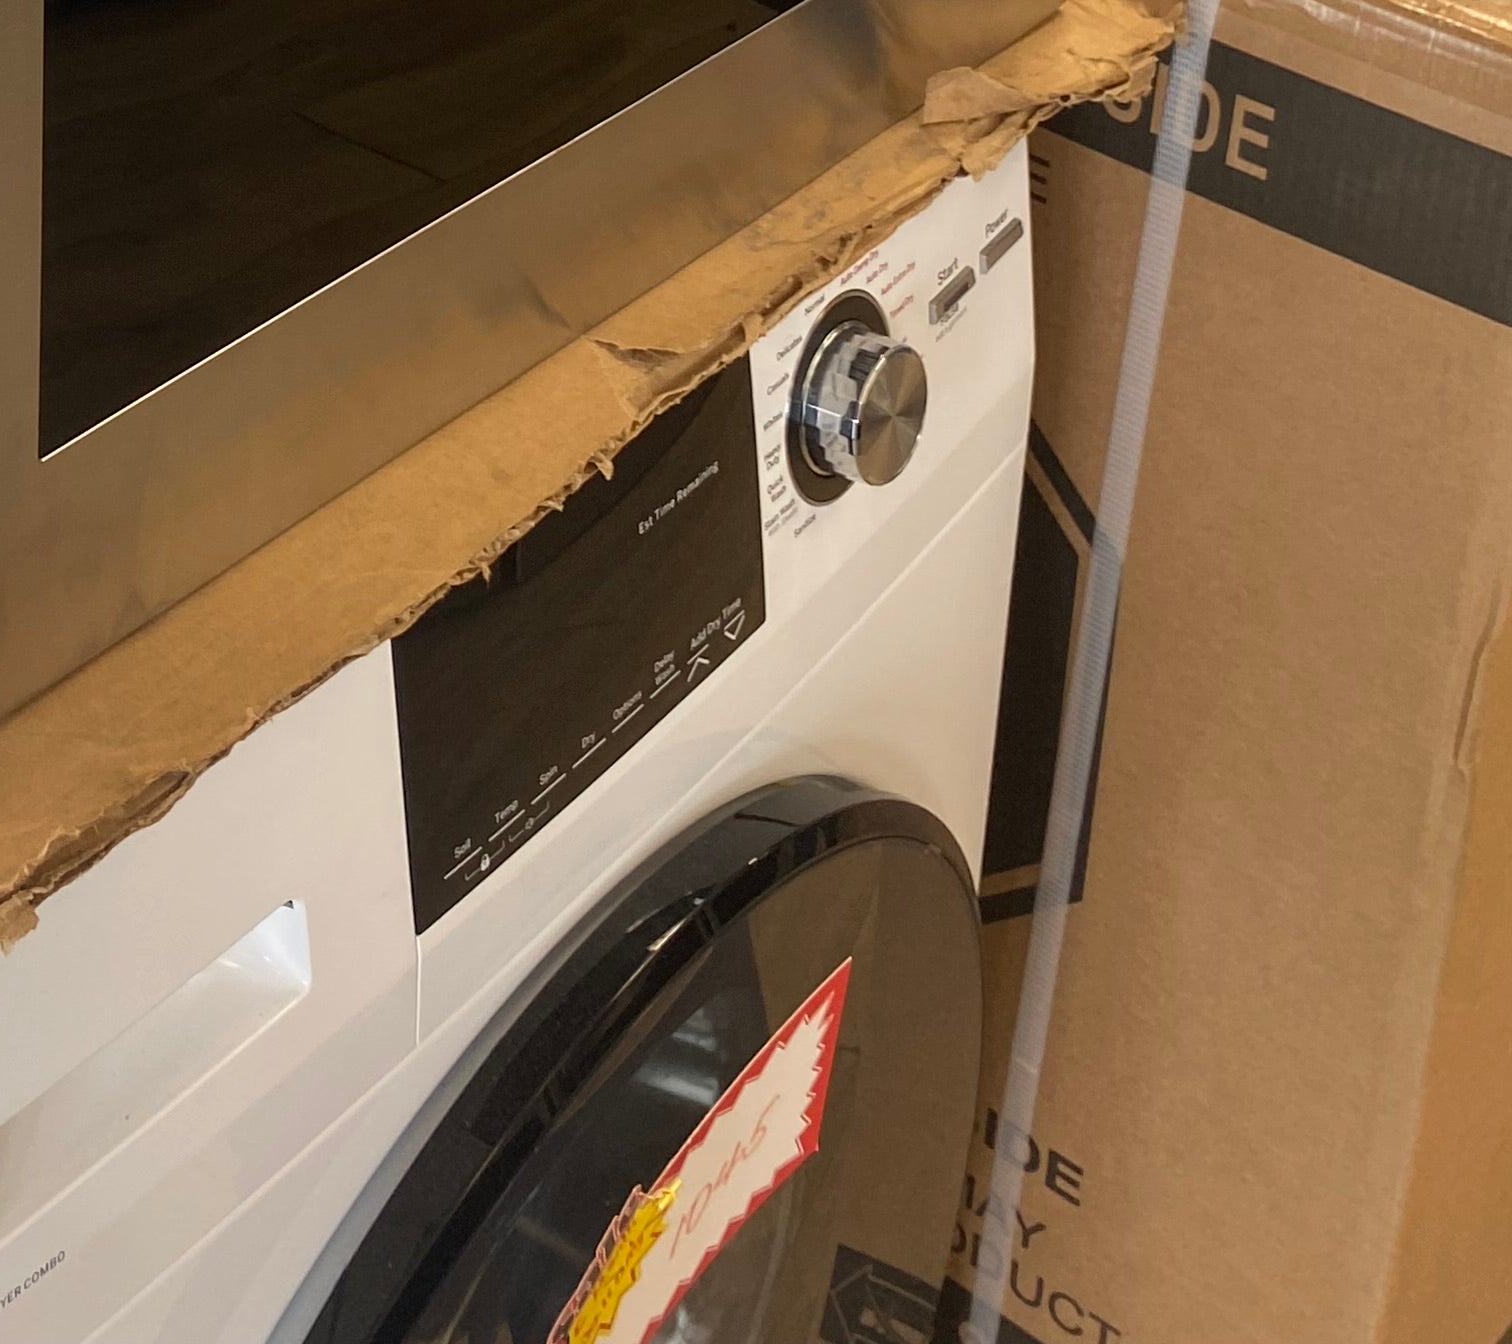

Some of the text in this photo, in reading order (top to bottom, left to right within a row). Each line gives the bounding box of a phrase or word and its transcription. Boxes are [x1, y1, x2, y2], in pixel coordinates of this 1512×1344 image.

[985, 208, 1008, 239] Power
[937, 257, 958, 286] Start
[638, 460, 719, 534] Est Time Remaining
[690, 597, 742, 651] Add Dry Time
[654, 650, 676, 673] Delay
[612, 690, 642, 721] Options
[581, 731, 597, 749] Dry
[539, 765, 558, 786] Spin
[494, 799, 519, 824] Temp
[454, 837, 471, 859] Soil
[23, 1250, 65, 1290] COMBO
